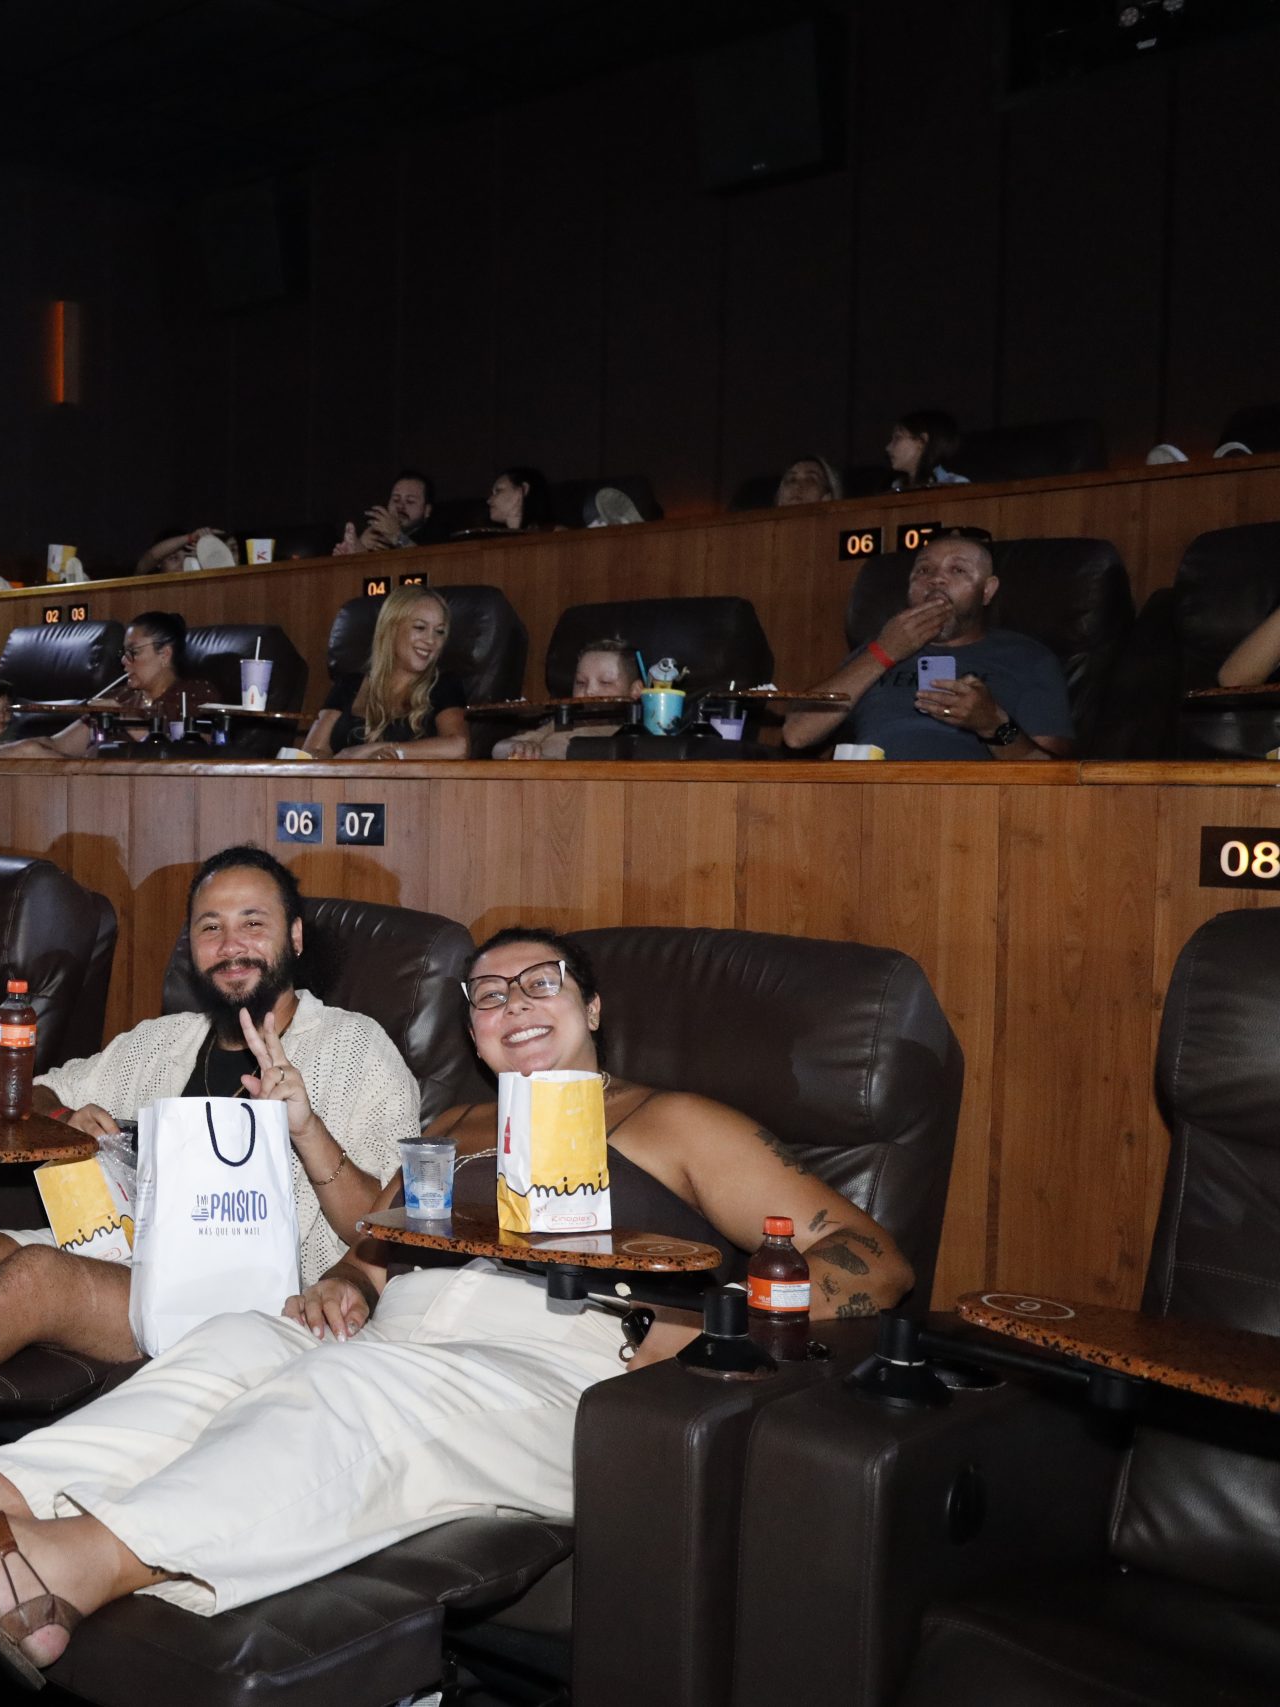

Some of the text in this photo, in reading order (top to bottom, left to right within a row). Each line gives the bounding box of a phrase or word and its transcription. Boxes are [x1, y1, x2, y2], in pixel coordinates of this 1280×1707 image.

[847, 534, 874, 555] 06
[367, 581, 386, 597] 04
[45, 609, 60, 624] 02
[71, 607, 85, 621] 03
[285, 810, 313, 835] 06
[345, 811, 375, 837] 07
[1220, 840, 1280, 879] 08
[528, 1172, 610, 1198] mini
[210, 1189, 268, 1223] PAISITO
[215, 1227, 228, 1237] QUE
[232, 1227, 241, 1235] UN
